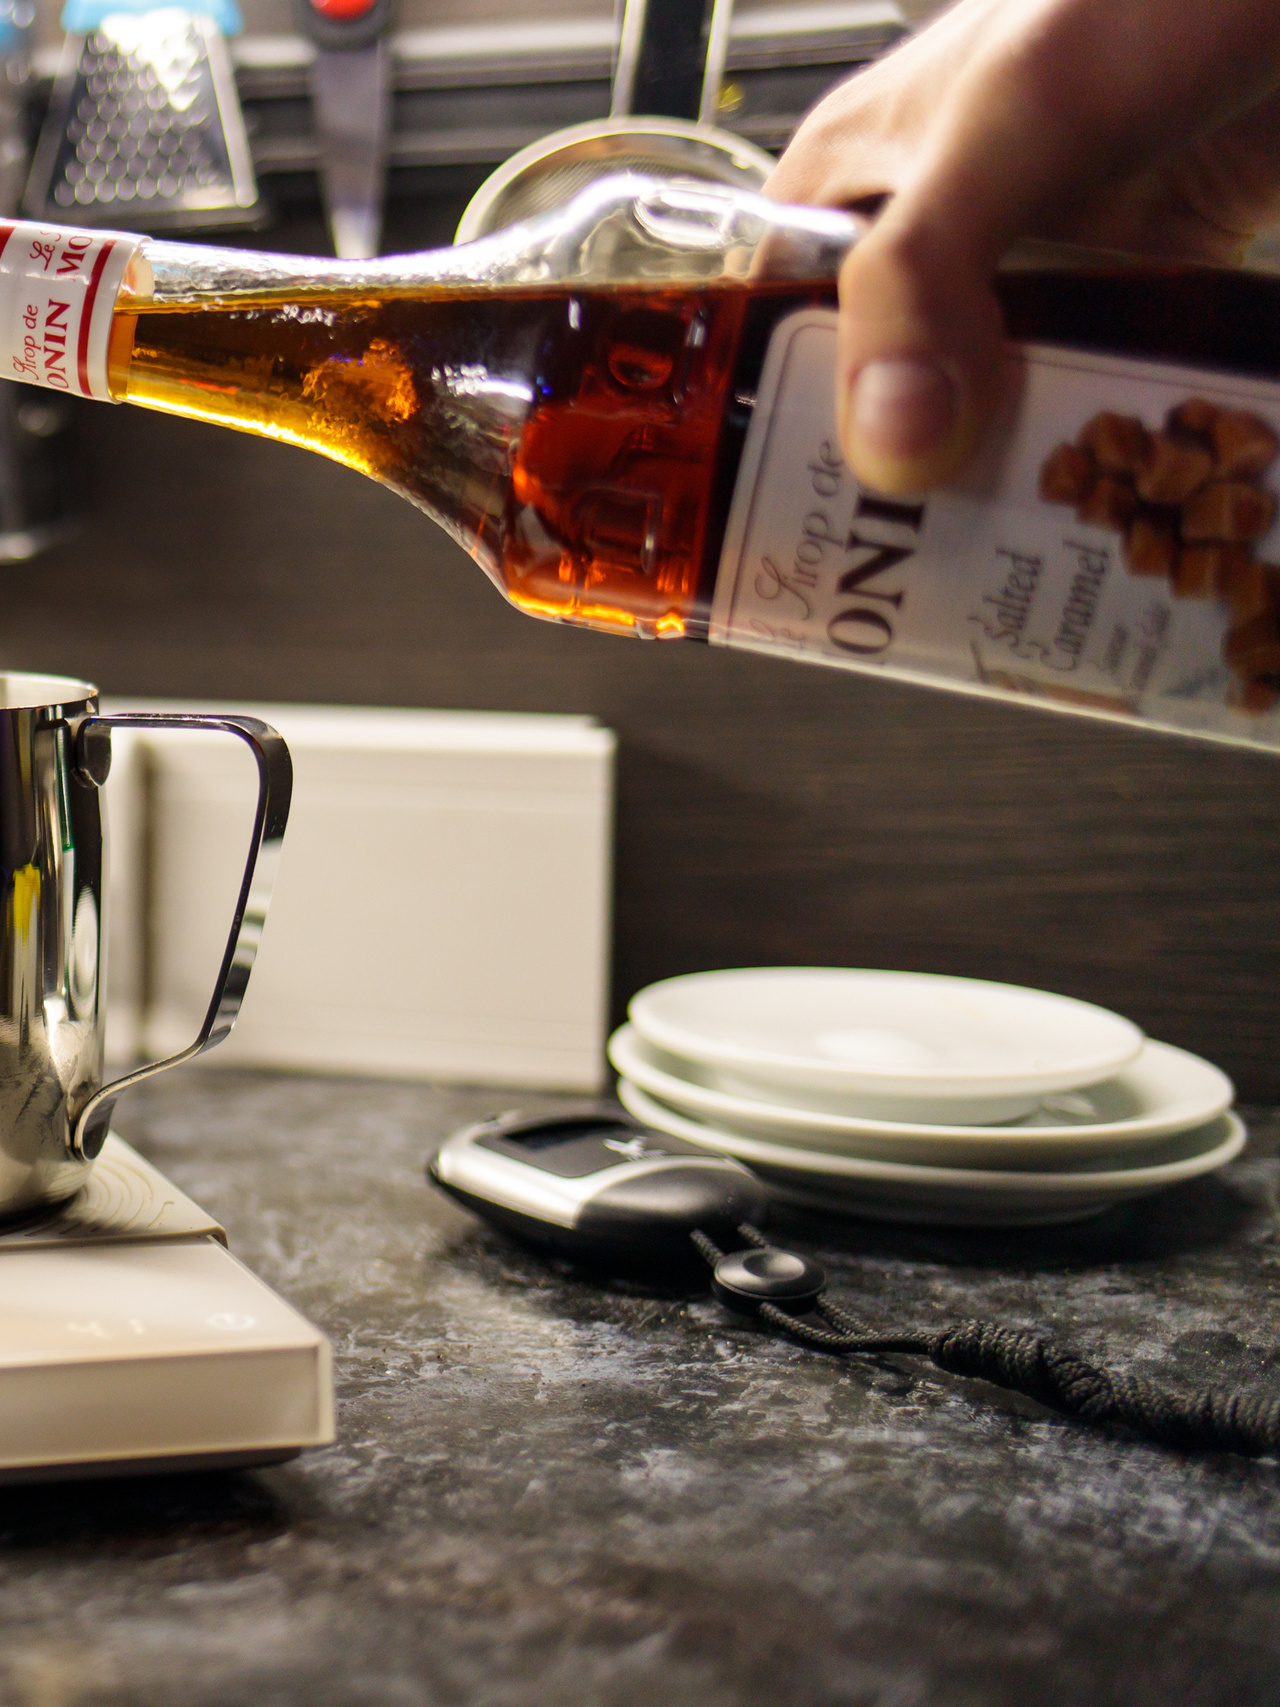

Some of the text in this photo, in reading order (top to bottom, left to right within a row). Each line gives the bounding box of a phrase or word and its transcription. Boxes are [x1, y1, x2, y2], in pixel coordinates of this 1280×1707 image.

[29, 241, 56, 271] Le
[12, 304, 41, 380] Sirop de
[753, 440, 845, 621] Sirop de
[967, 547, 1043, 659] Salted
[1028, 538, 1110, 672] Caramel
